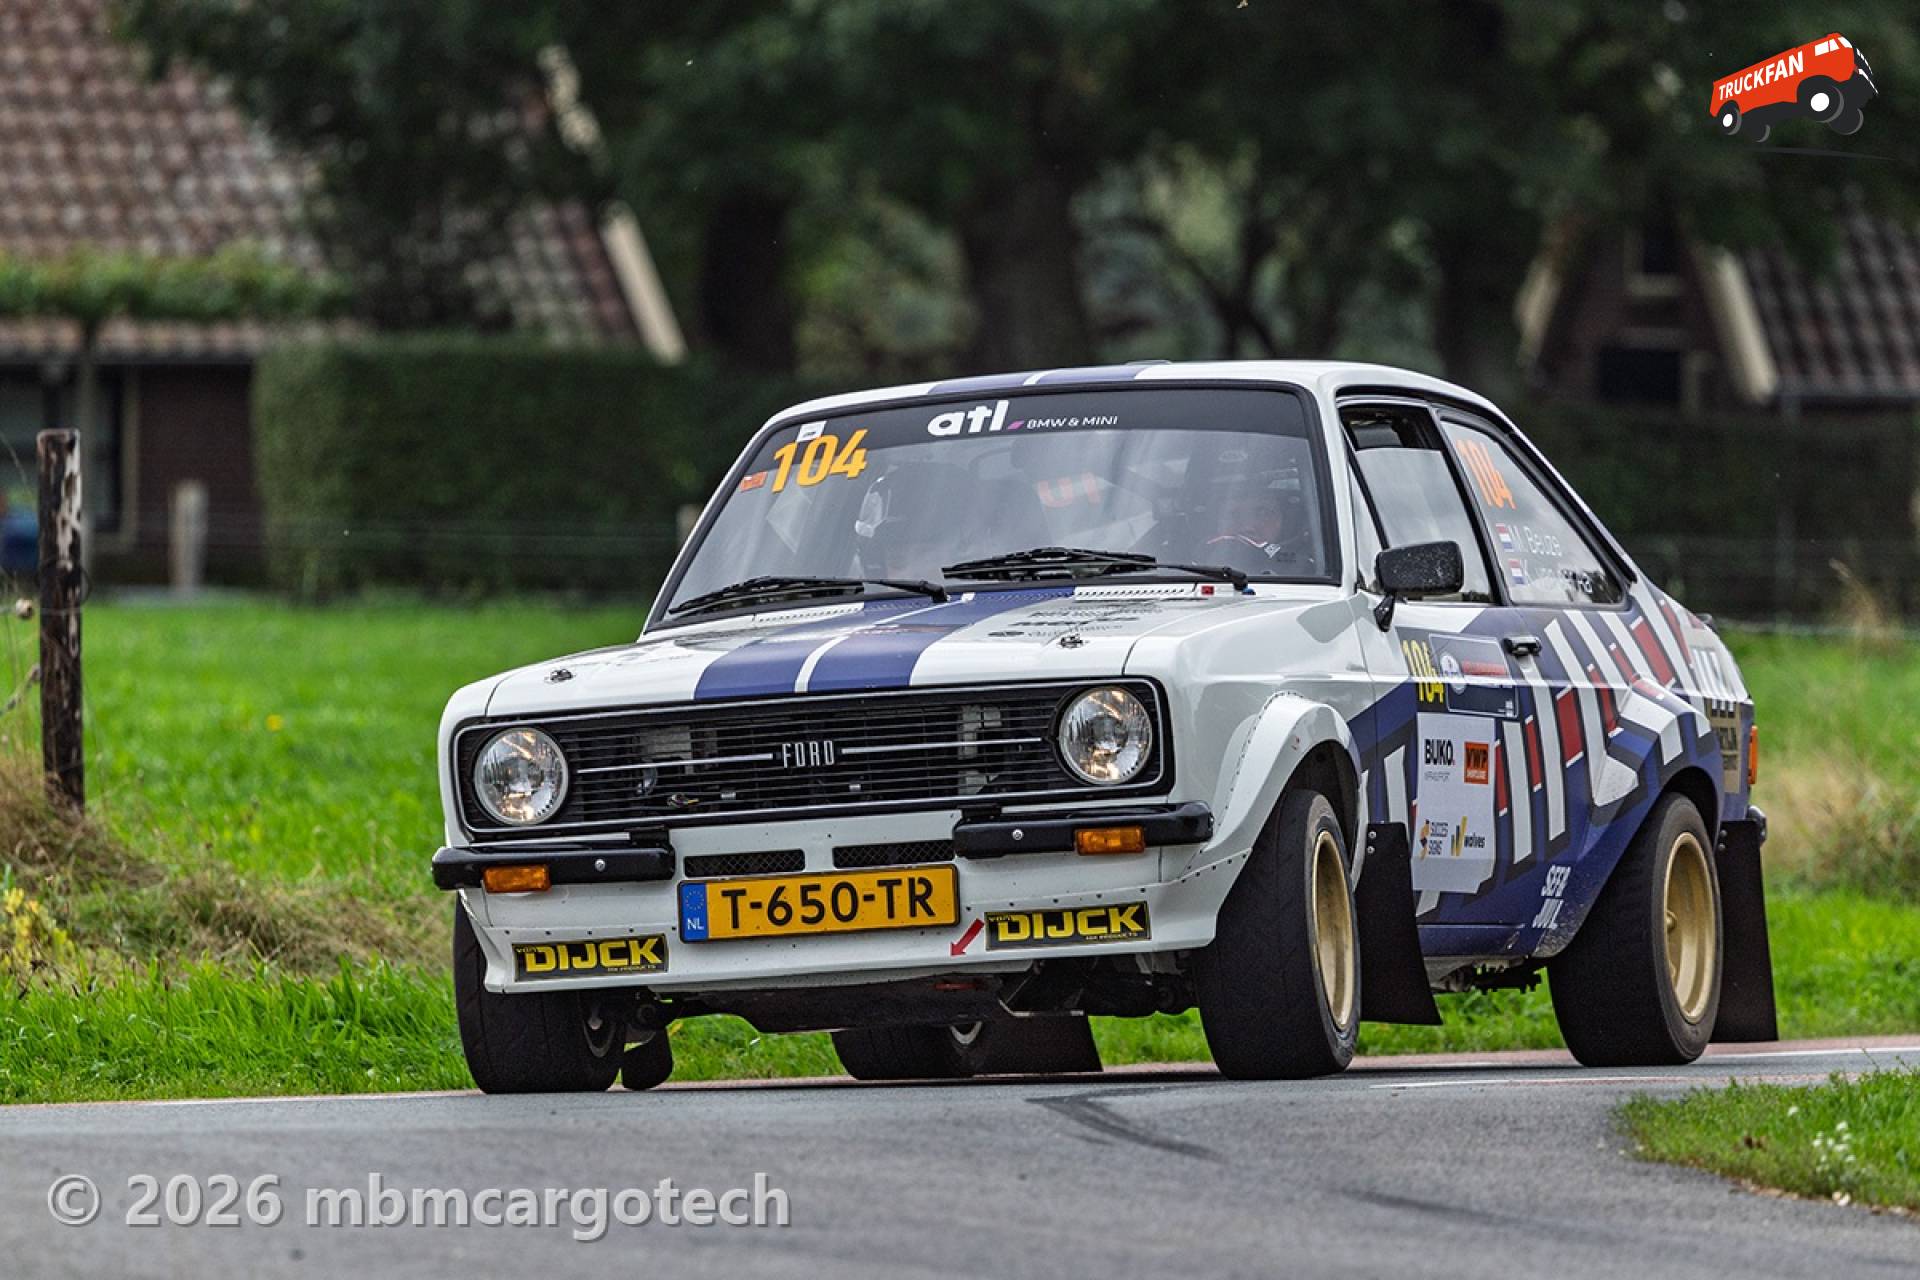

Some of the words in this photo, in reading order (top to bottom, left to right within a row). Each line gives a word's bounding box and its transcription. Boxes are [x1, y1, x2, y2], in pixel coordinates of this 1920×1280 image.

[927, 400, 1009, 436] atl
[1026, 417, 1065, 430] BMW
[1068, 416, 1079, 427] &
[1082, 415, 1118, 426] MINI
[771, 429, 868, 493] 104
[1402, 639, 1444, 704] 104
[782, 740, 834, 769] FORD
[721, 876, 936, 929] T-650-TR
[687, 917, 704, 931] NL
[998, 904, 1144, 942] DIJCK
[525, 938, 662, 973] DIJCK
